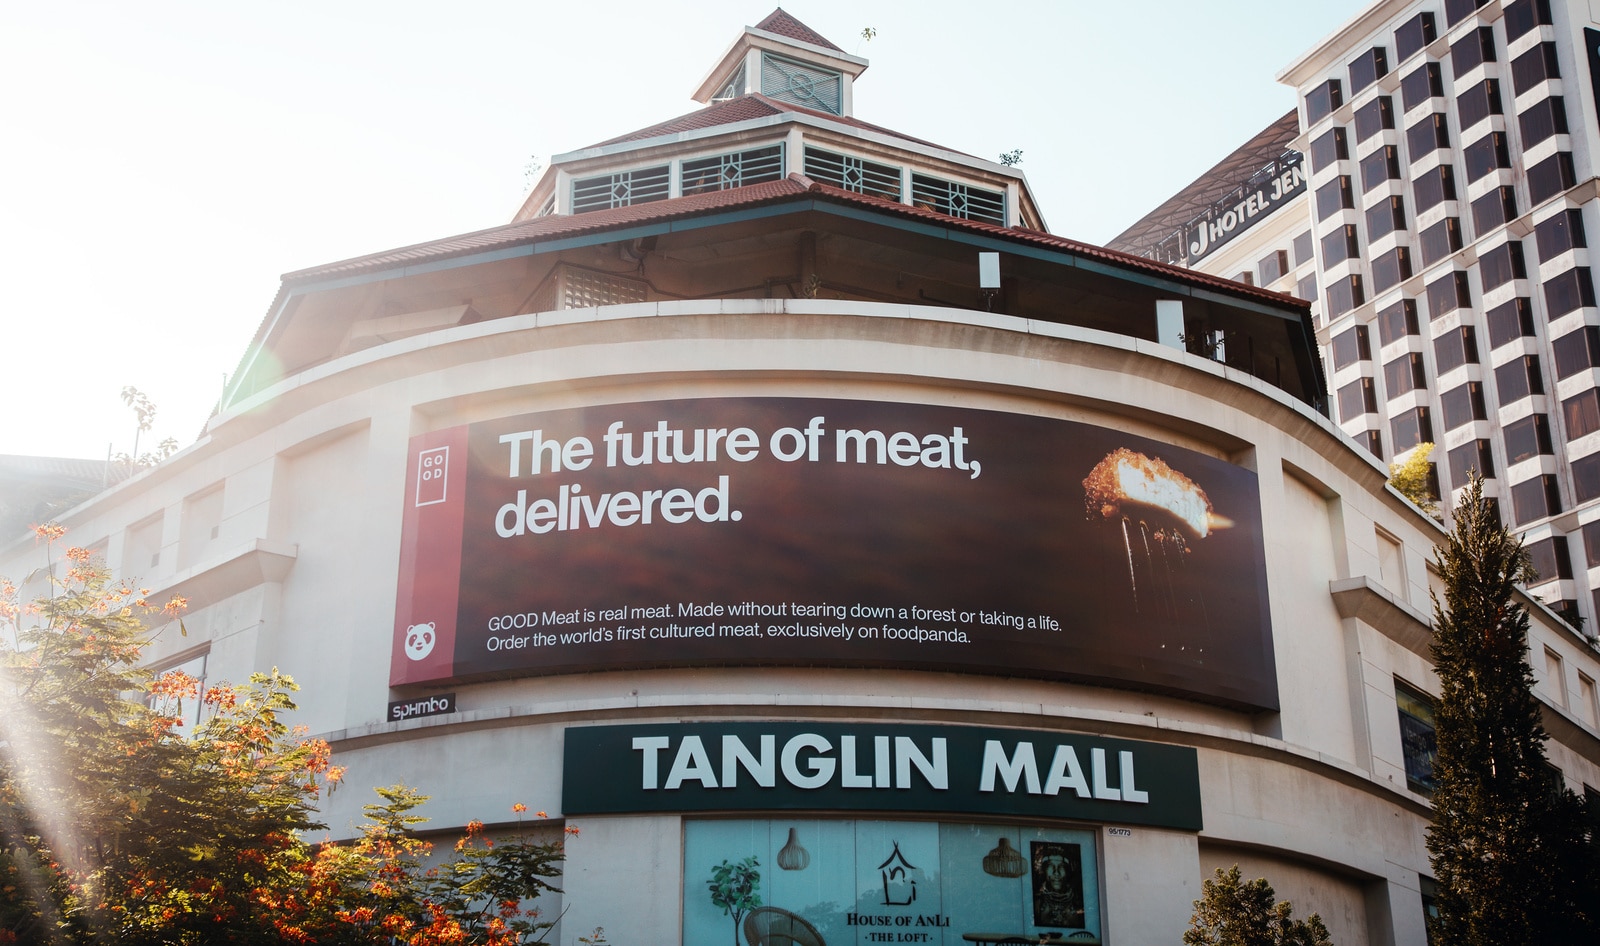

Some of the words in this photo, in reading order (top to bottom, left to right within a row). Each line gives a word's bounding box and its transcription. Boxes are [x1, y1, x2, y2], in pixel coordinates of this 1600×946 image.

[1209, 190, 1270, 242] HOTEL
[499, 429, 594, 478] The
[603, 420, 760, 467] future
[769, 416, 825, 462] of
[836, 426, 982, 480] meat,
[495, 475, 743, 538] delivered.
[487, 635, 530, 652] Order
[533, 632, 557, 647] the
[559, 627, 614, 645] world's
[616, 625, 647, 641] first
[649, 622, 715, 639] cultured
[719, 623, 764, 638] meat,
[767, 622, 855, 640] exclusively
[858, 627, 879, 639] on
[882, 625, 972, 643] foodpanda.
[488, 612, 539, 632] GOOD
[541, 609, 581, 626] Meat
[583, 608, 596, 623] is
[599, 605, 628, 622] real
[631, 604, 675, 620] meat.
[678, 602, 725, 617] Made
[728, 602, 788, 616] without
[791, 602, 847, 620] tearing
[850, 603, 895, 619] down
[898, 608, 909, 620] a
[911, 605, 957, 622] forest
[959, 611, 976, 623] or
[979, 610, 1025, 631] taking
[1027, 617, 1037, 629] a
[1039, 615, 1063, 632] life.
[632, 733, 949, 790] TANGLIN
[979, 739, 1149, 803] MALL
[847, 913, 892, 927] HOUSE
[894, 916, 913, 927] OF
[869, 932, 894, 942] THE
[897, 933, 929, 943] LOFT
